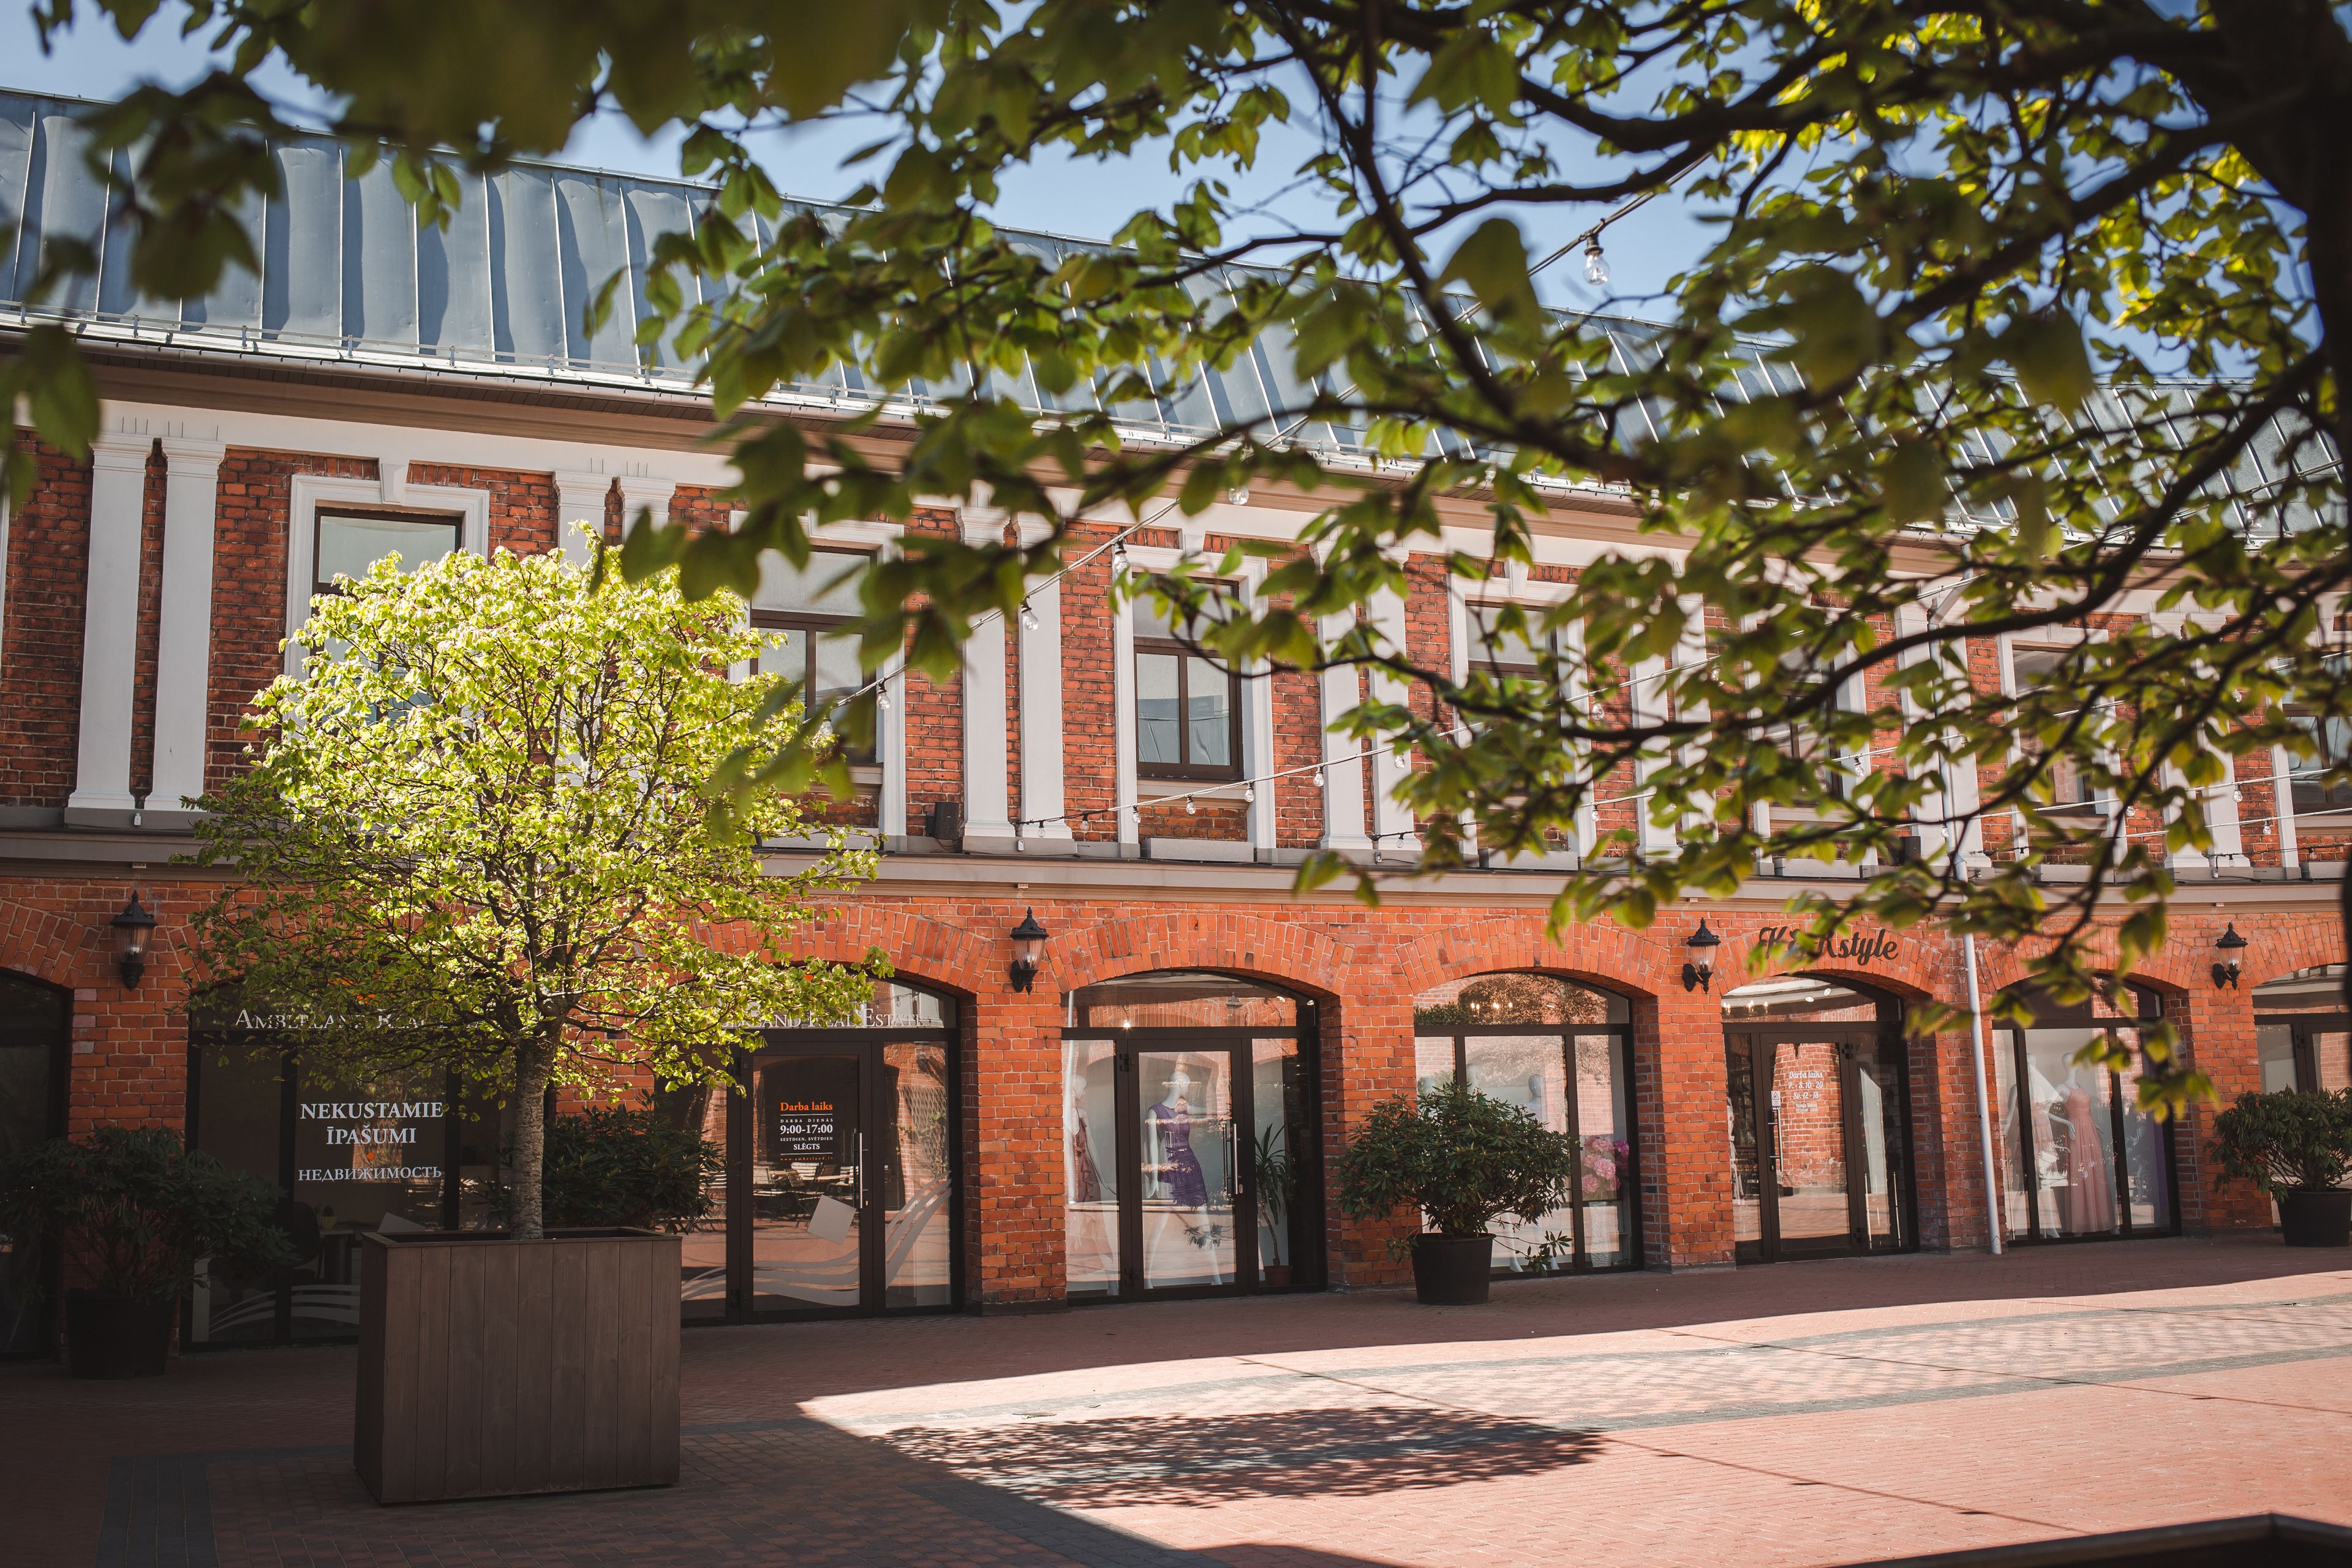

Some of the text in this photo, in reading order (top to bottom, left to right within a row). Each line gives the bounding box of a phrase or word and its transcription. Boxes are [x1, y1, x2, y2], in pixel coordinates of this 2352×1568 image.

[300, 1102, 443, 1119] NEKUSTAMIE
[780, 1101, 833, 1111] Darba laiks
[326, 1125, 417, 1145] ĪPAŠUMI
[780, 1124, 833, 1135] 9:00-17:00
[298, 1166, 442, 1183] НЕДВИЖИМОСТЬ
